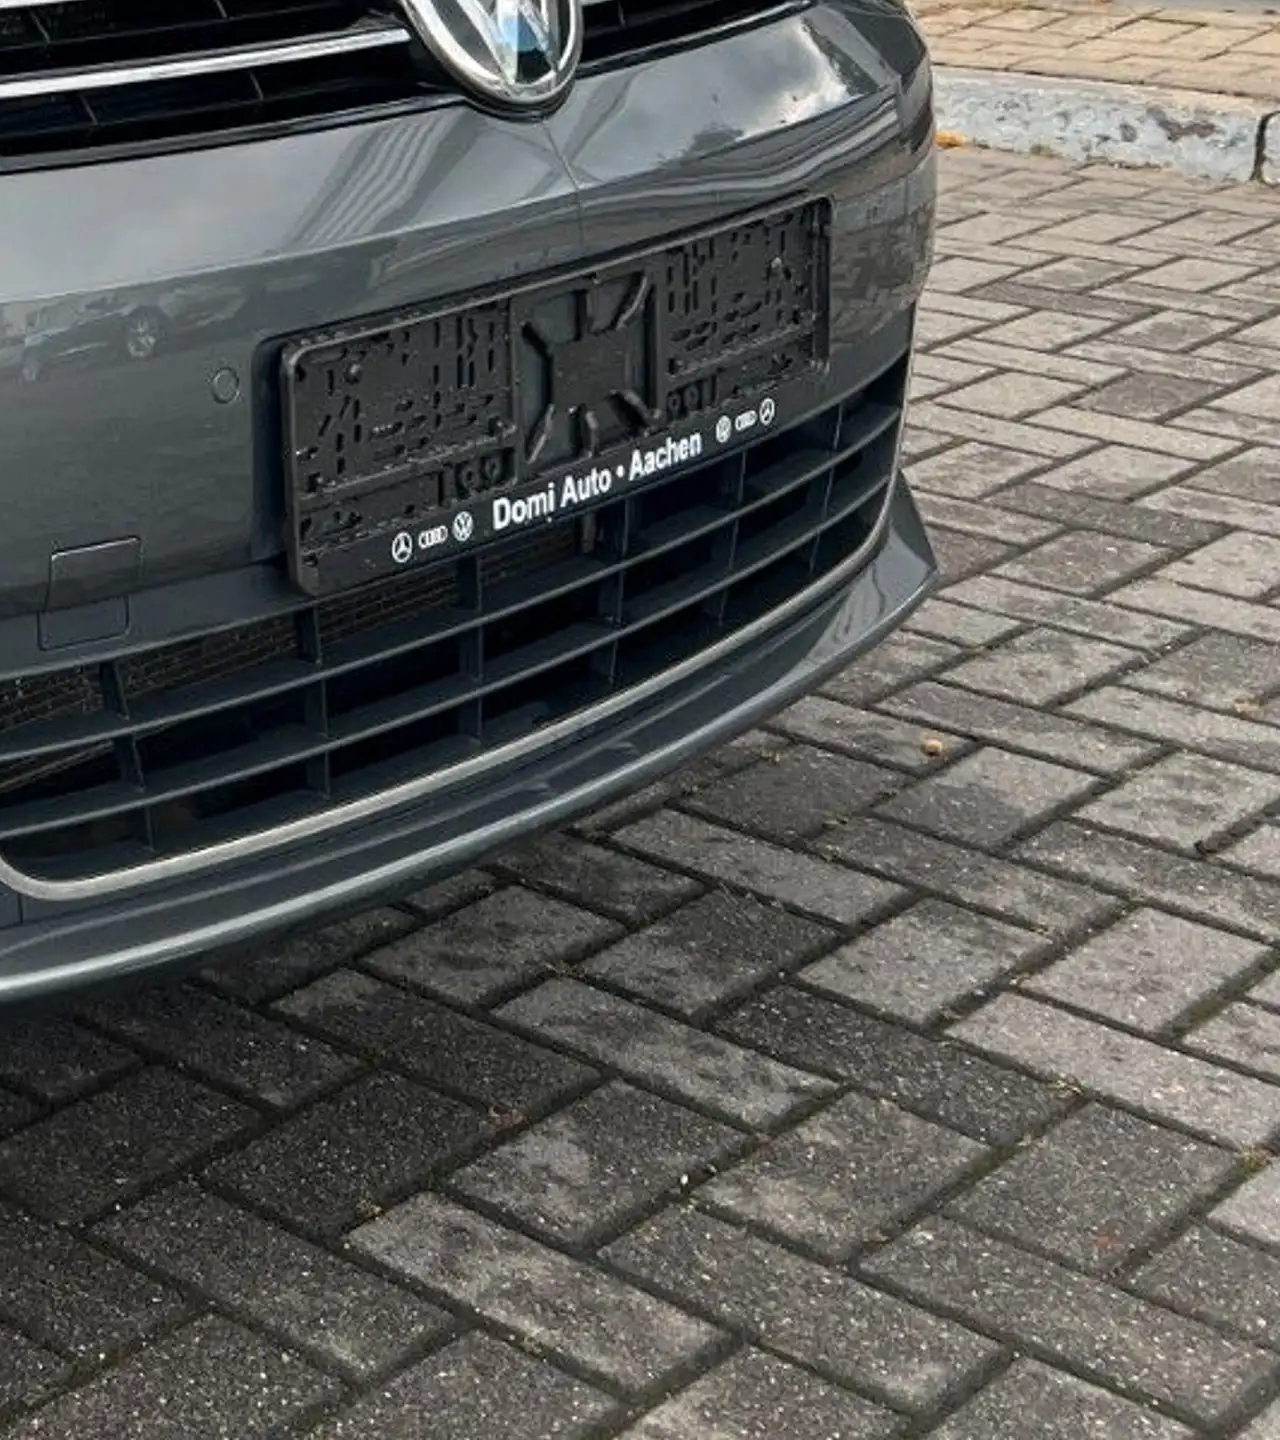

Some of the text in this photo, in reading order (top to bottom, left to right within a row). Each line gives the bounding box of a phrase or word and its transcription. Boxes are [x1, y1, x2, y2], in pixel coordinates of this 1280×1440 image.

[492, 431, 702, 531] Domi Auto Aachen
